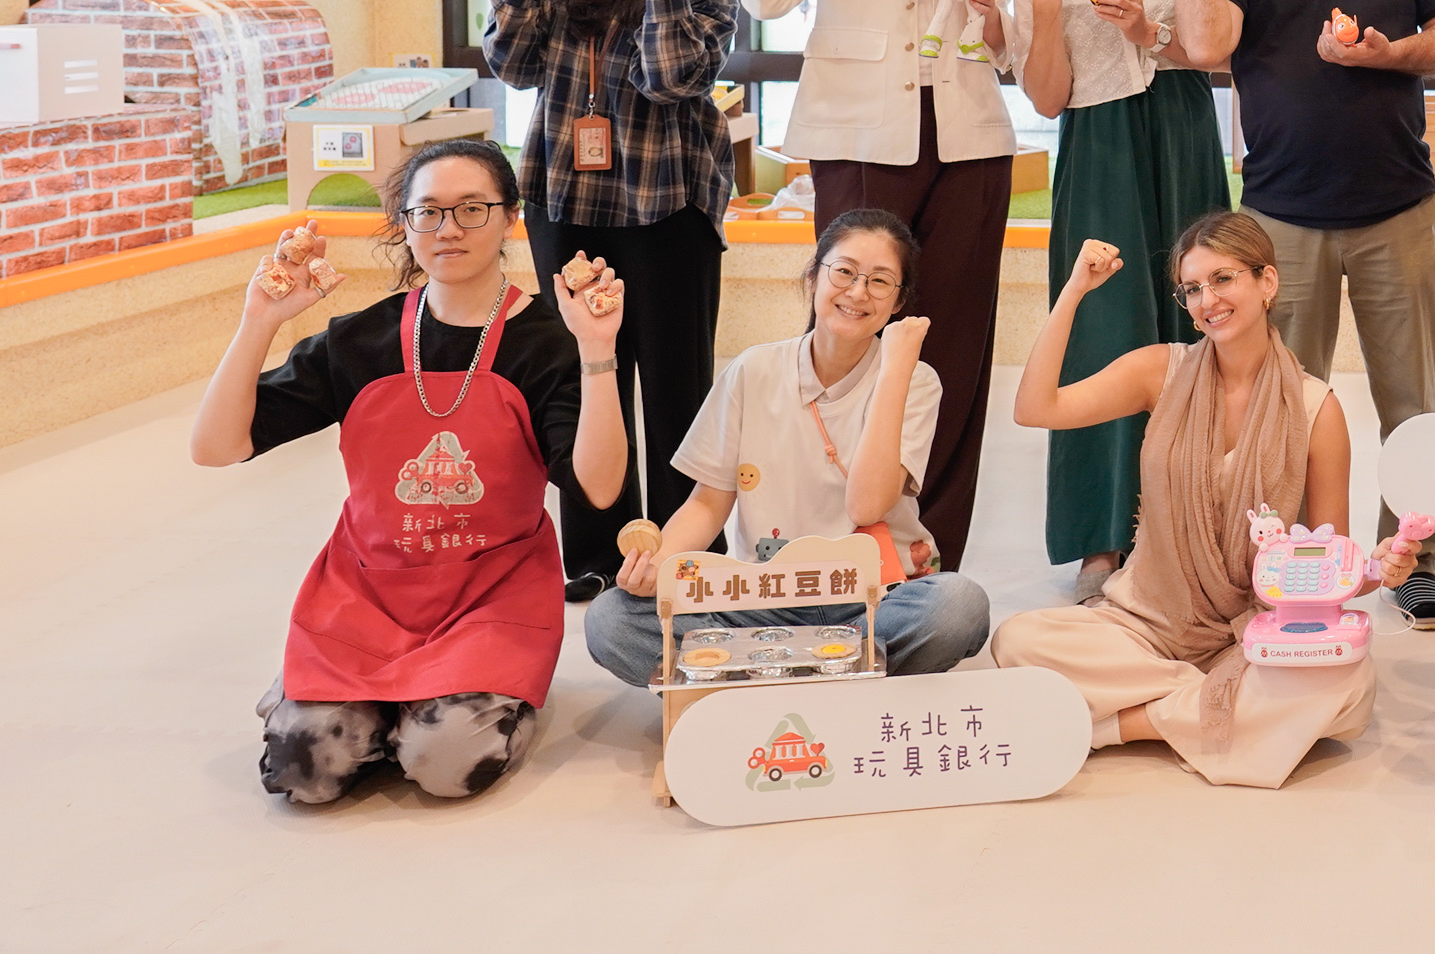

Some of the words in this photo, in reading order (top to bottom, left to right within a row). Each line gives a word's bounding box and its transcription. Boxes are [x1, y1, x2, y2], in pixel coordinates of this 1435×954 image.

[402, 512, 471, 533] 新北市
[393, 533, 487, 553] 玩具銀行
[686, 568, 858, 603] 小小紅豆餅
[1294, 649, 1333, 657] REGISTER
[880, 704, 984, 743] 新北市
[853, 743, 1012, 778] 玩具銀行
